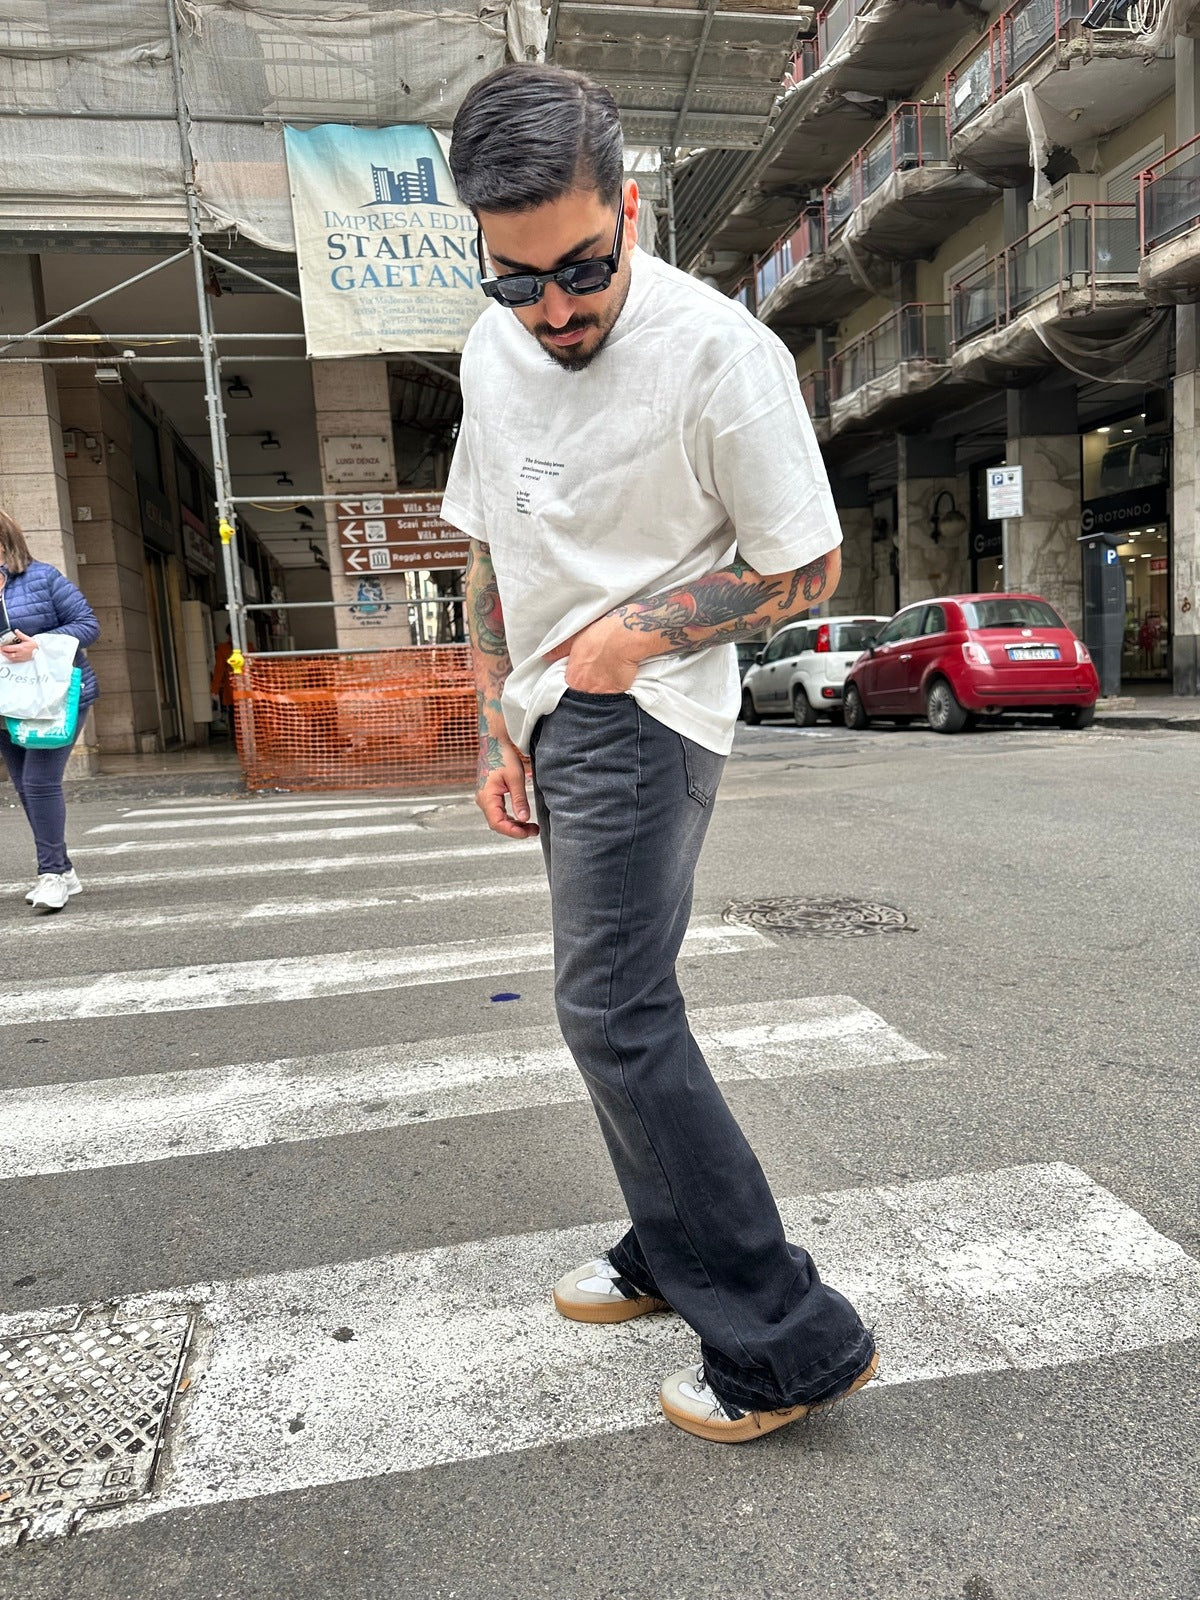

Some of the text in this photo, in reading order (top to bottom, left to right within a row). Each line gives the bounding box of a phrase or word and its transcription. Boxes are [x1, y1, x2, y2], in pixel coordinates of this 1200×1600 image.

[324, 211, 424, 231] IMPRESA
[356, 457, 380, 465] DENZA
[403, 503, 423, 513] Villa
[1081, 503, 1151, 531] GIROTONDO
[397, 519, 419, 529] Scavi
[417, 530, 437, 540] Villa
[392, 552, 421, 562] Reggia
[423, 551, 432, 560] di
[1107, 549, 1116, 564] P
